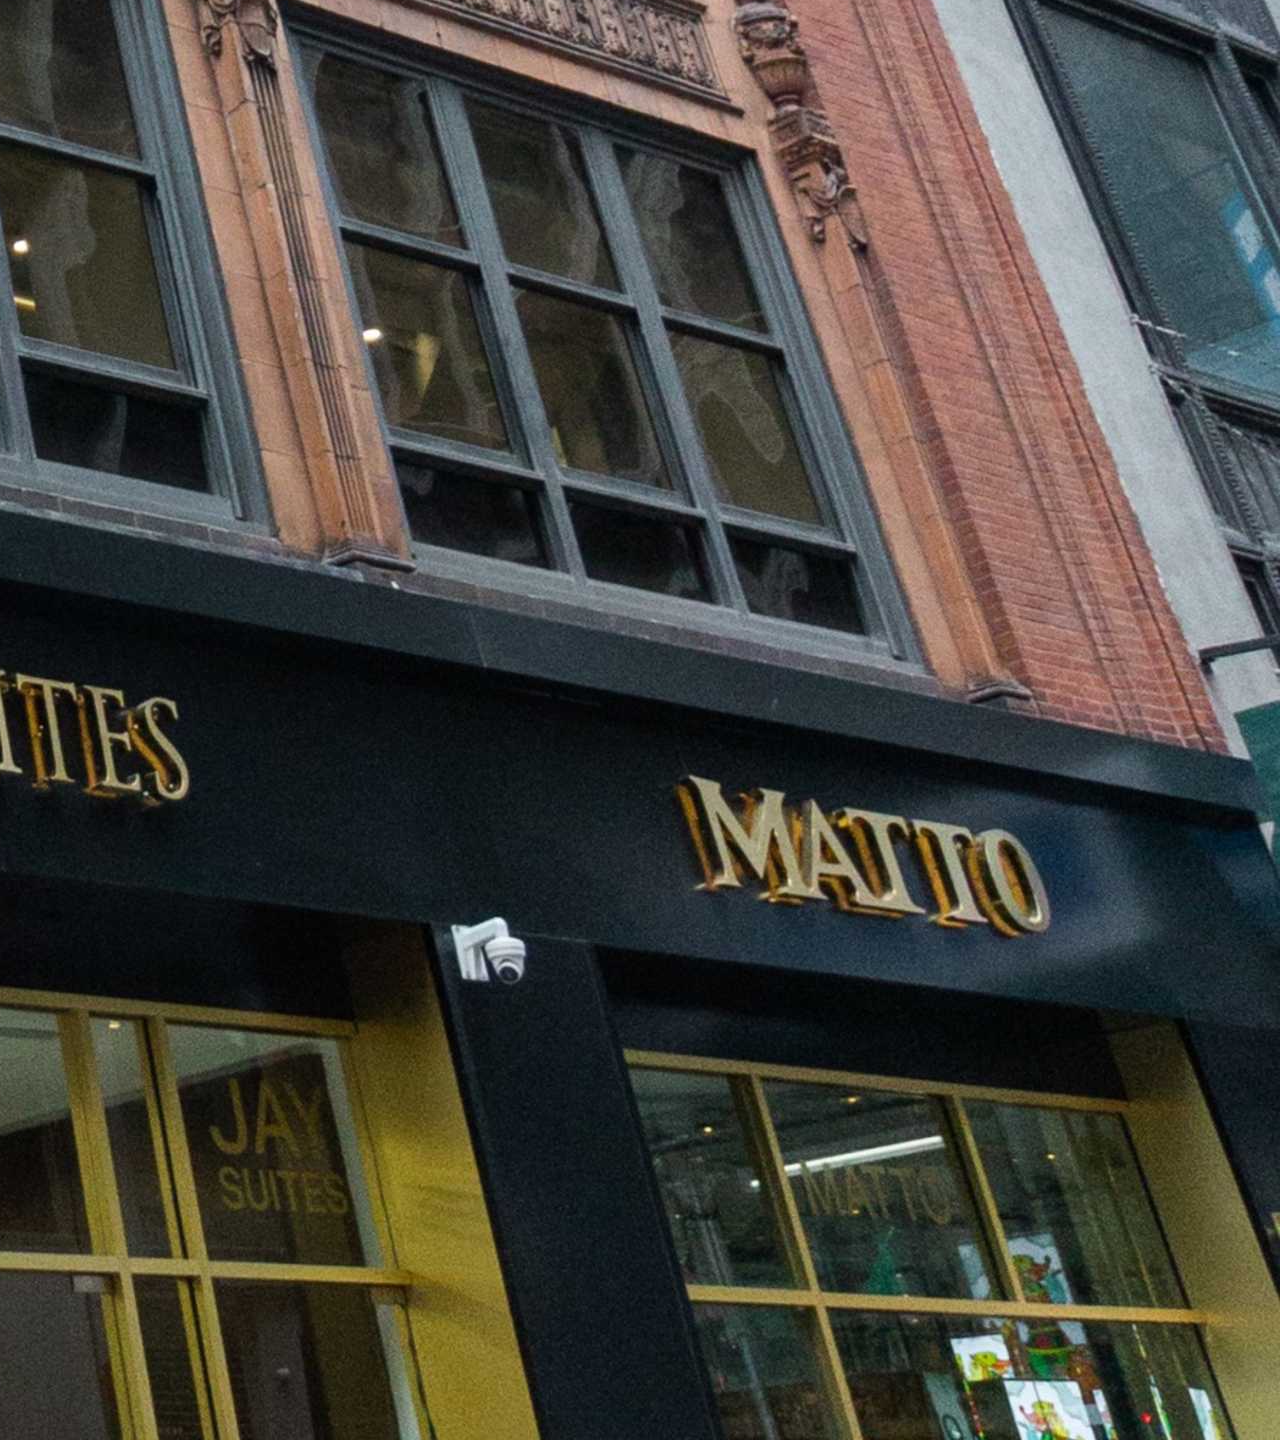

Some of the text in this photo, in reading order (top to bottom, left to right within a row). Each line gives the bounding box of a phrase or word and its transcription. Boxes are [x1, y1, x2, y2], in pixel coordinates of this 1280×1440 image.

[677, 775, 1050, 937] MATTO
[209, 1073, 324, 1157] JAY
[218, 1166, 349, 1214] SUITES
